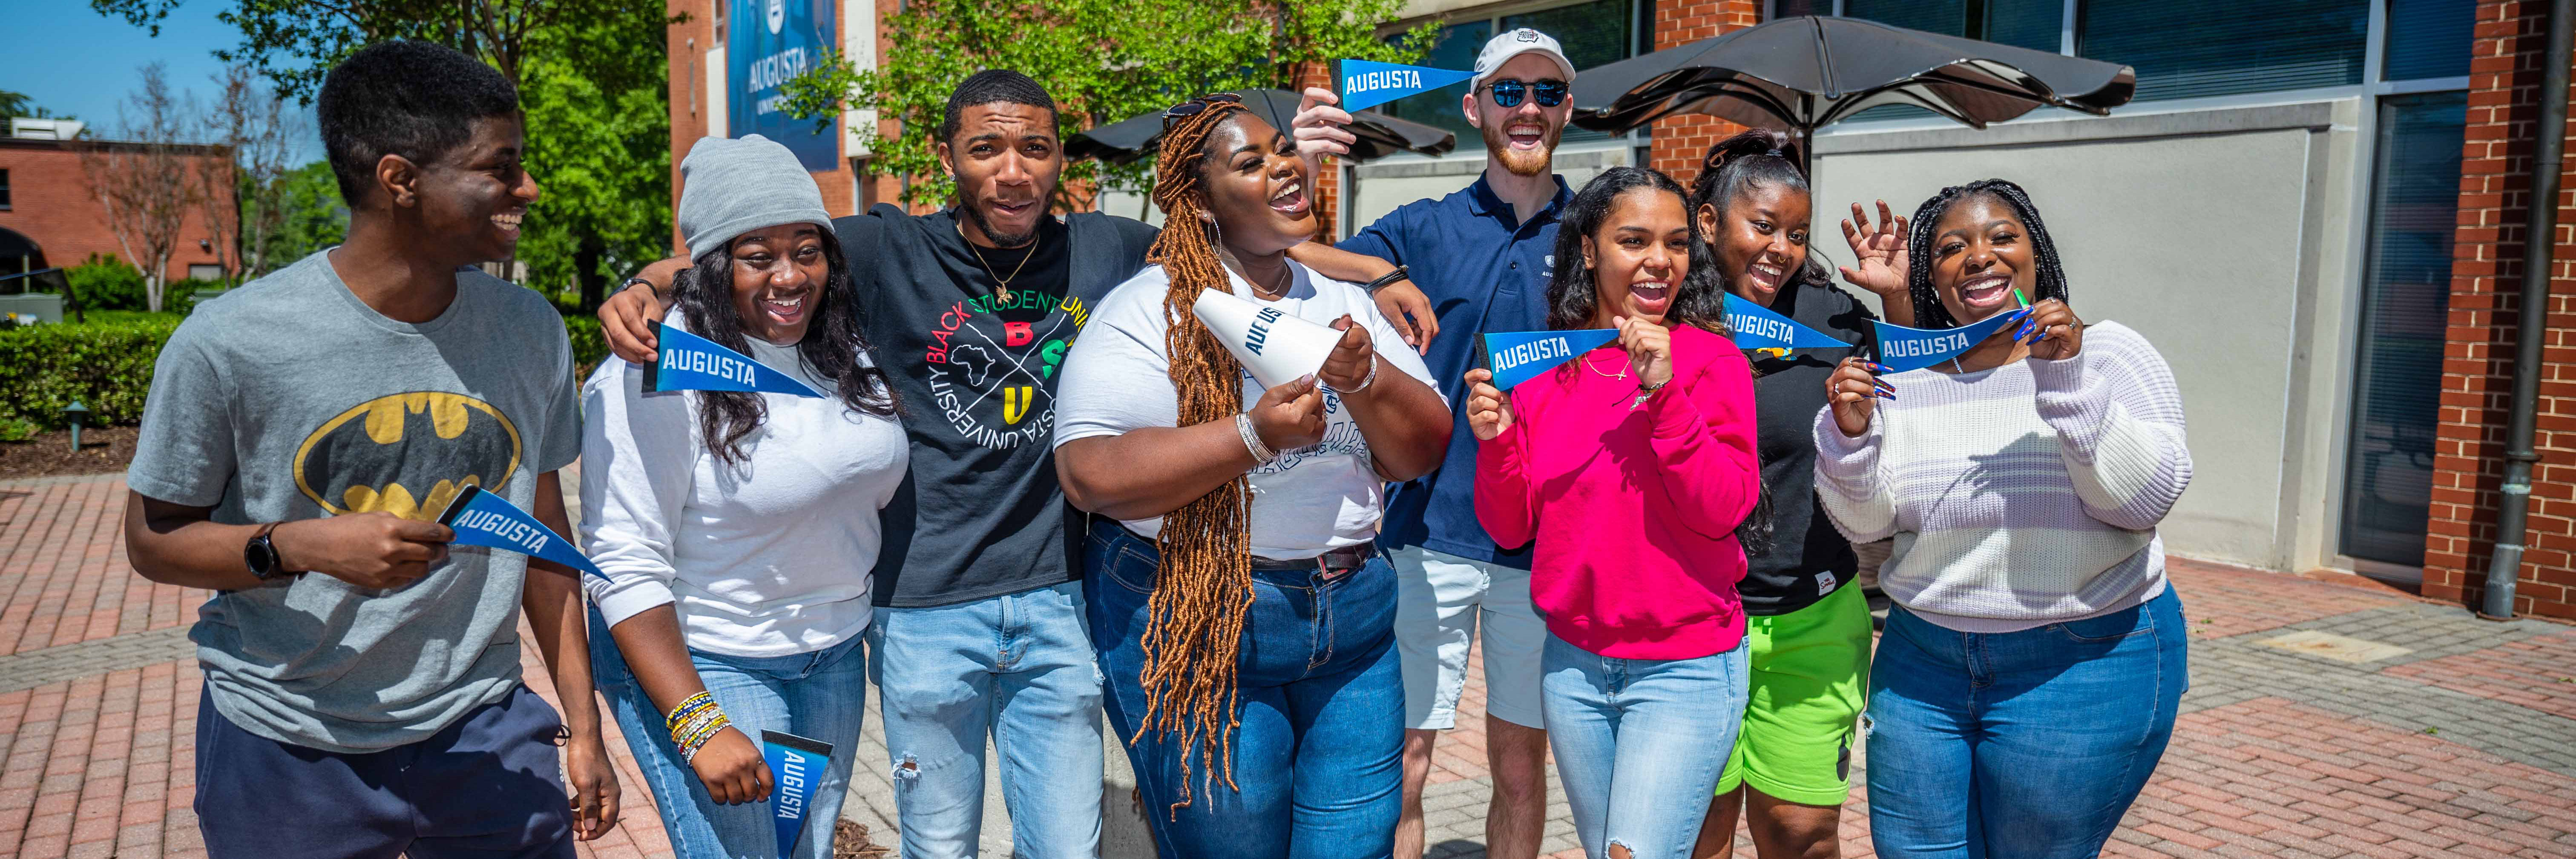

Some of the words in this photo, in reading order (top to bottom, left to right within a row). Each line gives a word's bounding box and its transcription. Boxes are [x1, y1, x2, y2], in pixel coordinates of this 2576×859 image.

[748, 46, 808, 93] AUGUSTA
[1346, 70, 1422, 95] AUGUSTA
[926, 301, 972, 364] BLACK
[967, 290, 1062, 314] STUDENT
[1003, 321, 1034, 346] B
[1724, 313, 1794, 345] AUGUSTA
[1884, 332, 1969, 357] AUGUSTA
[663, 349, 756, 388] AUGUSTA
[1041, 340, 1066, 380] S
[1495, 337, 1572, 373] AUGUSTA
[928, 365, 1019, 450] UNIVERSITY
[1003, 386, 1032, 425] U
[453, 509, 549, 554] AUGUSTA
[777, 750, 805, 819] AUGUSTA
